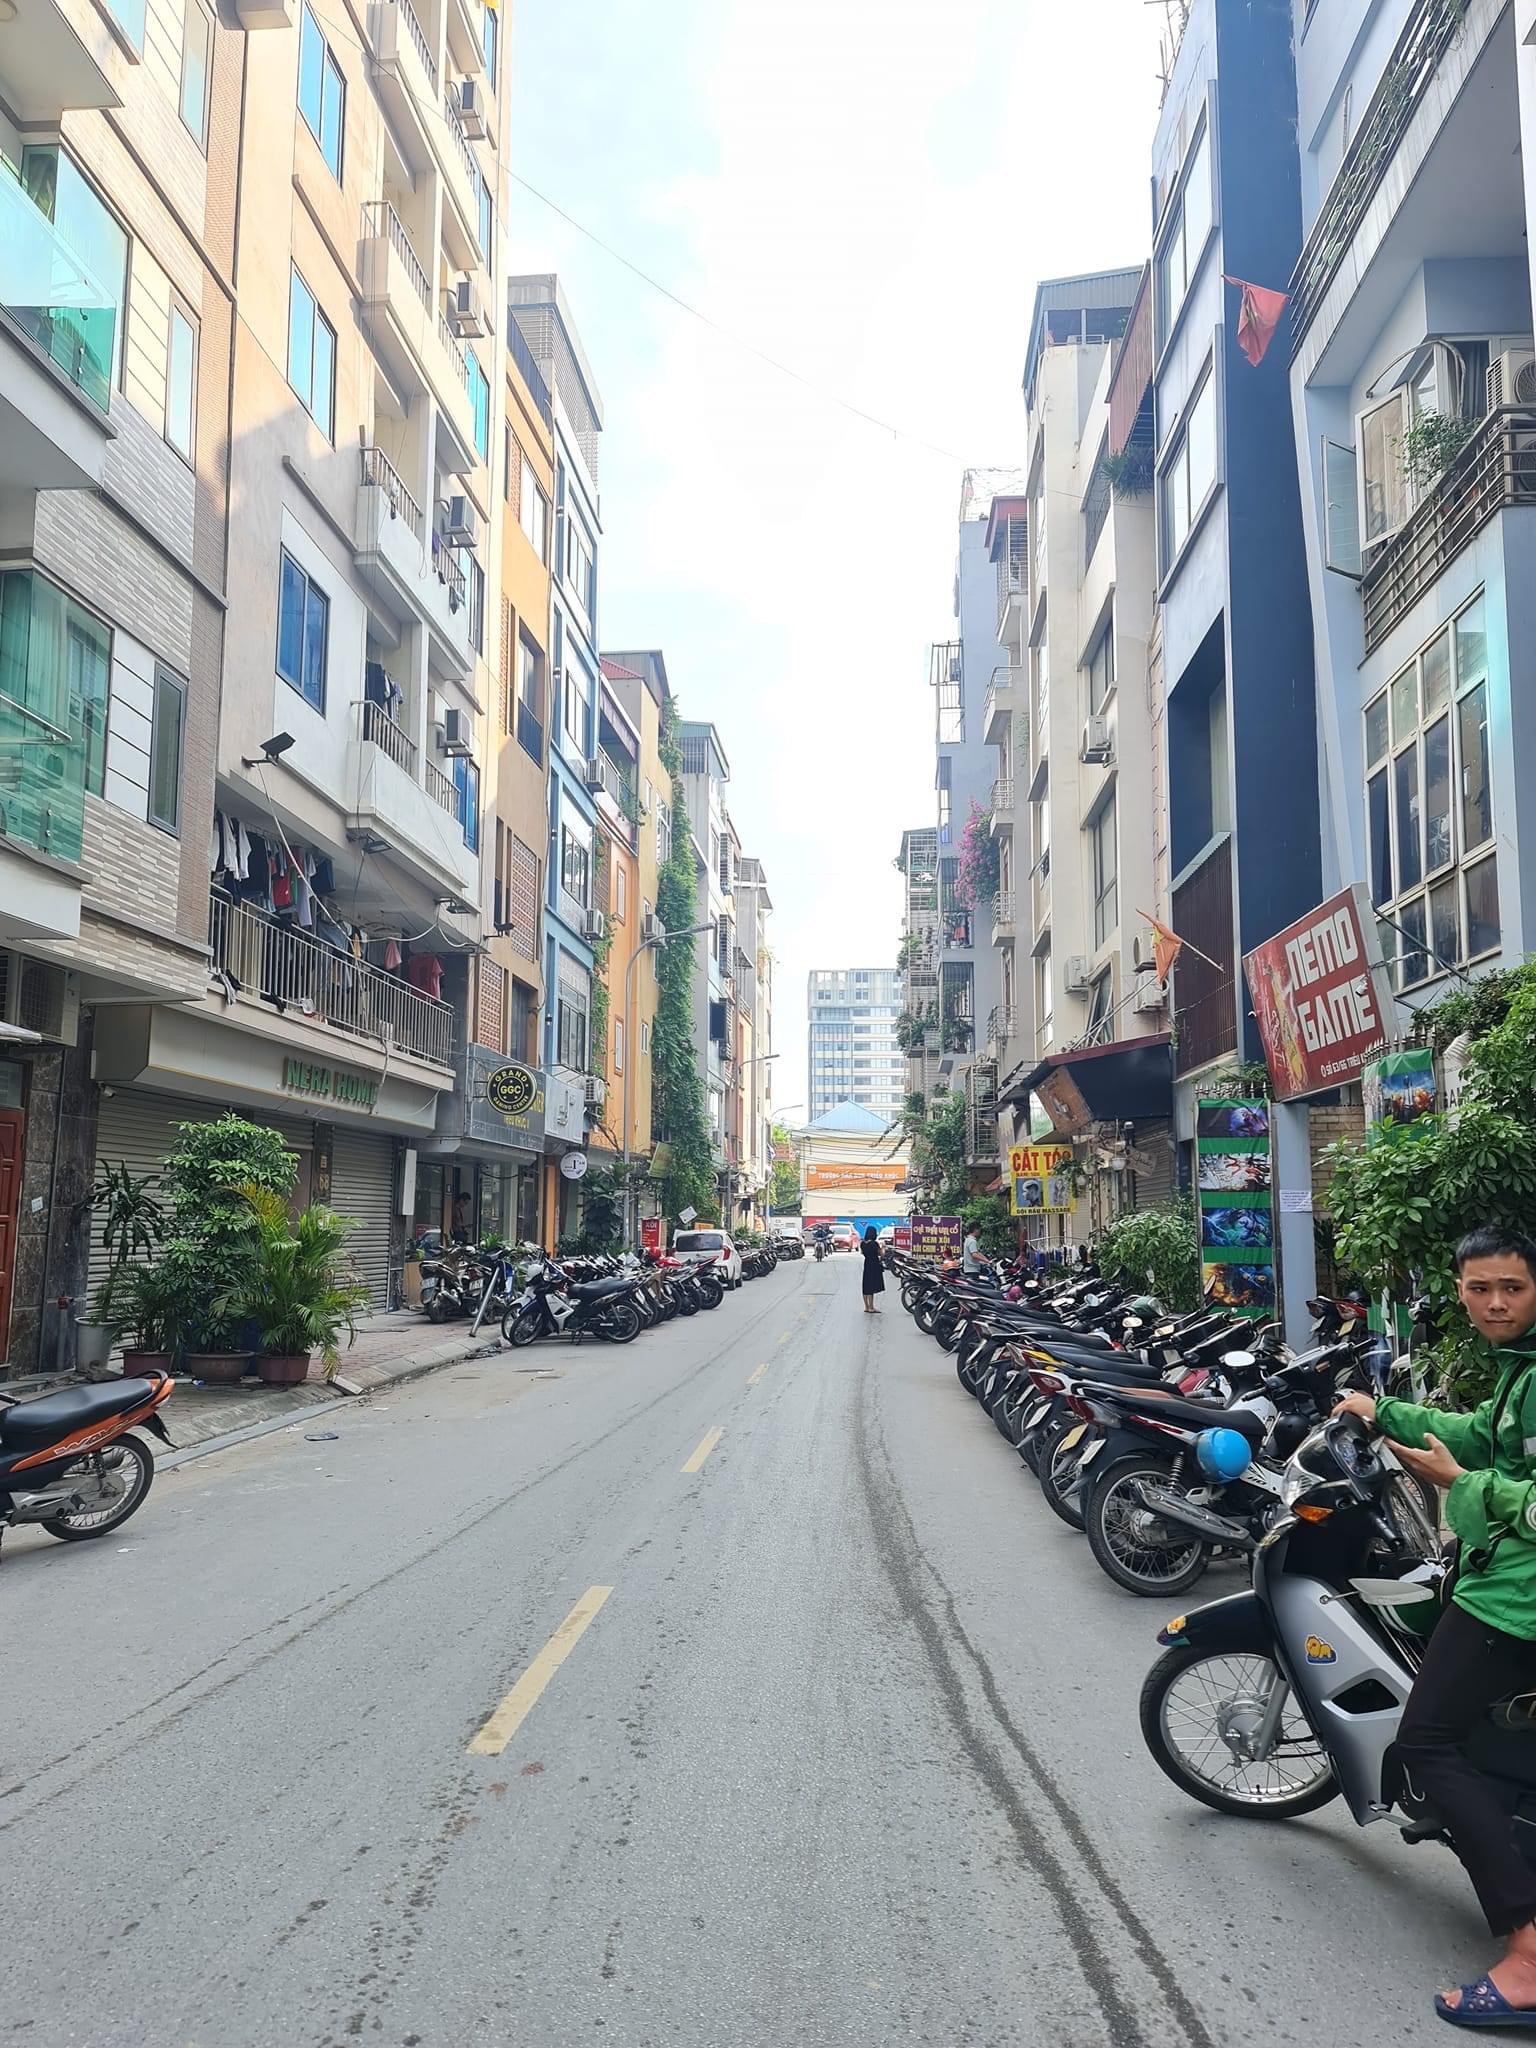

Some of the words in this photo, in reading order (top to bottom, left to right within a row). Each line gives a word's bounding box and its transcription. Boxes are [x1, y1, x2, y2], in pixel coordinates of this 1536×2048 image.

[1285, 906, 1359, 992] NEMO
[1297, 972, 1376, 1053] GAME
[282, 1056, 331, 1094] NERA
[494, 1070, 528, 1082] GRAND
[500, 1085, 521, 1094] GGC
